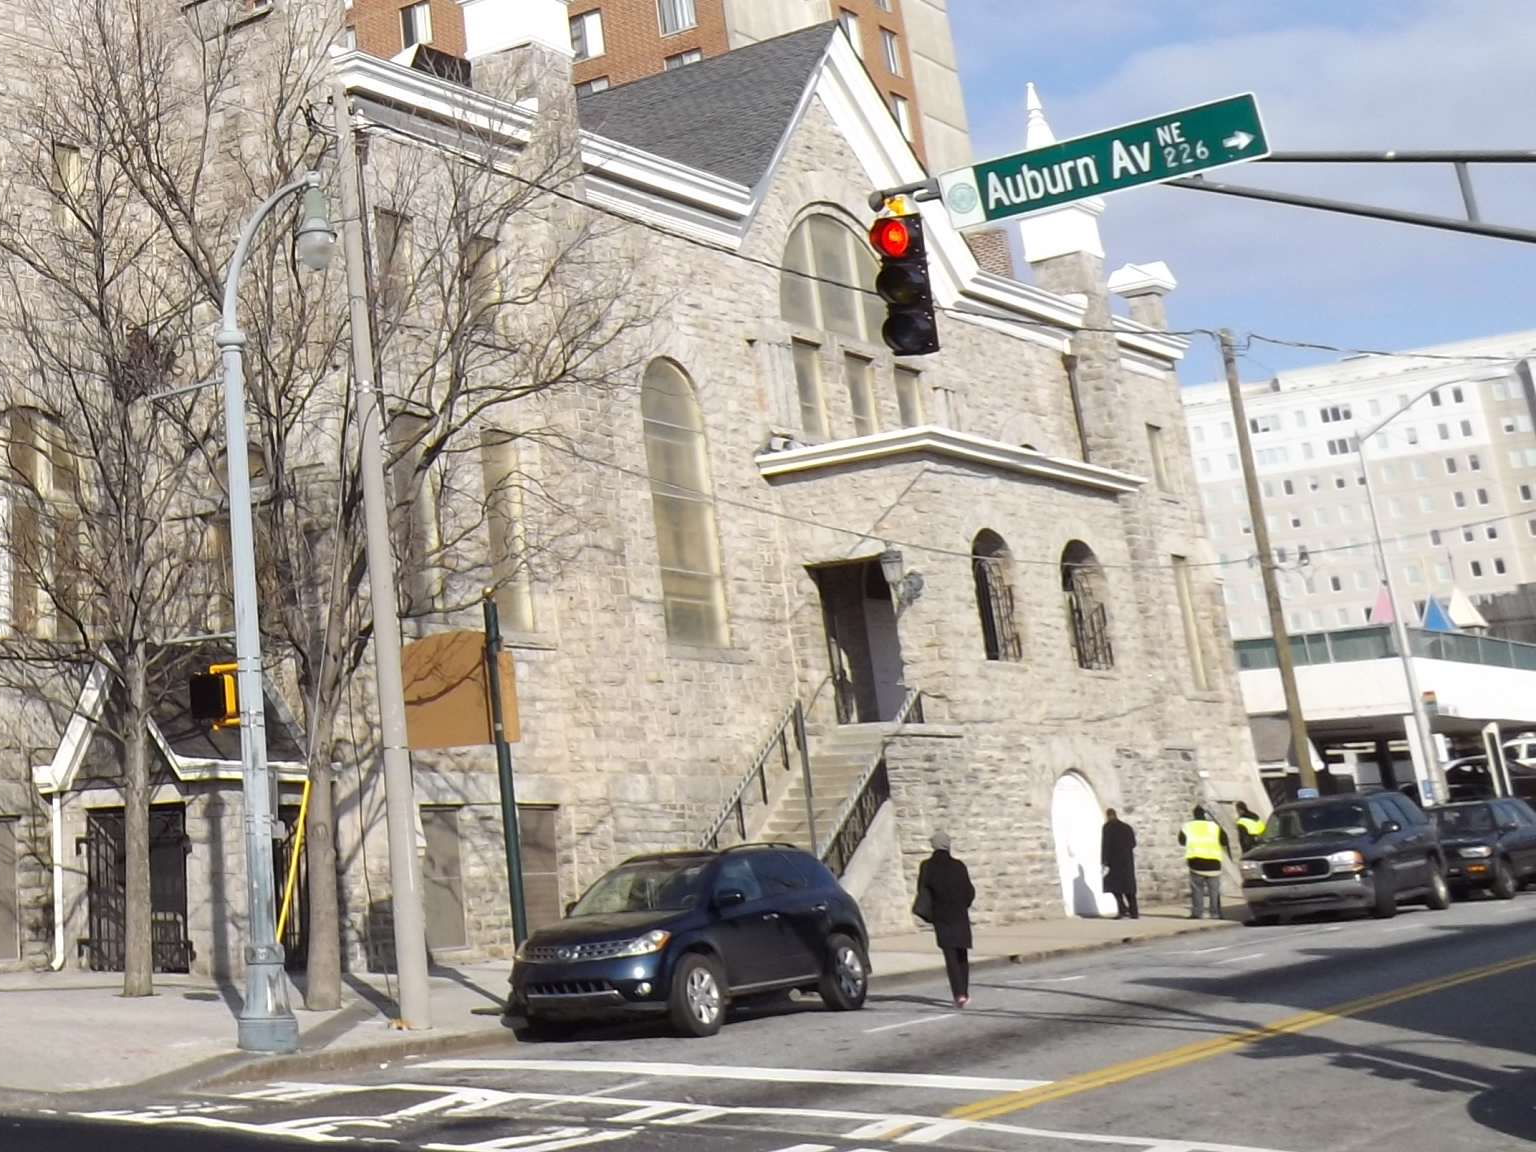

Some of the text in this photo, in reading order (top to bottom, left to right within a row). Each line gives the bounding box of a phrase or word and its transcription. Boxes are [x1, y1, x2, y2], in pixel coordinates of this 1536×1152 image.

[1155, 120, 1184, 148] NE
[1163, 144, 1210, 169] 226
[987, 137, 1152, 211] Auburn Av
